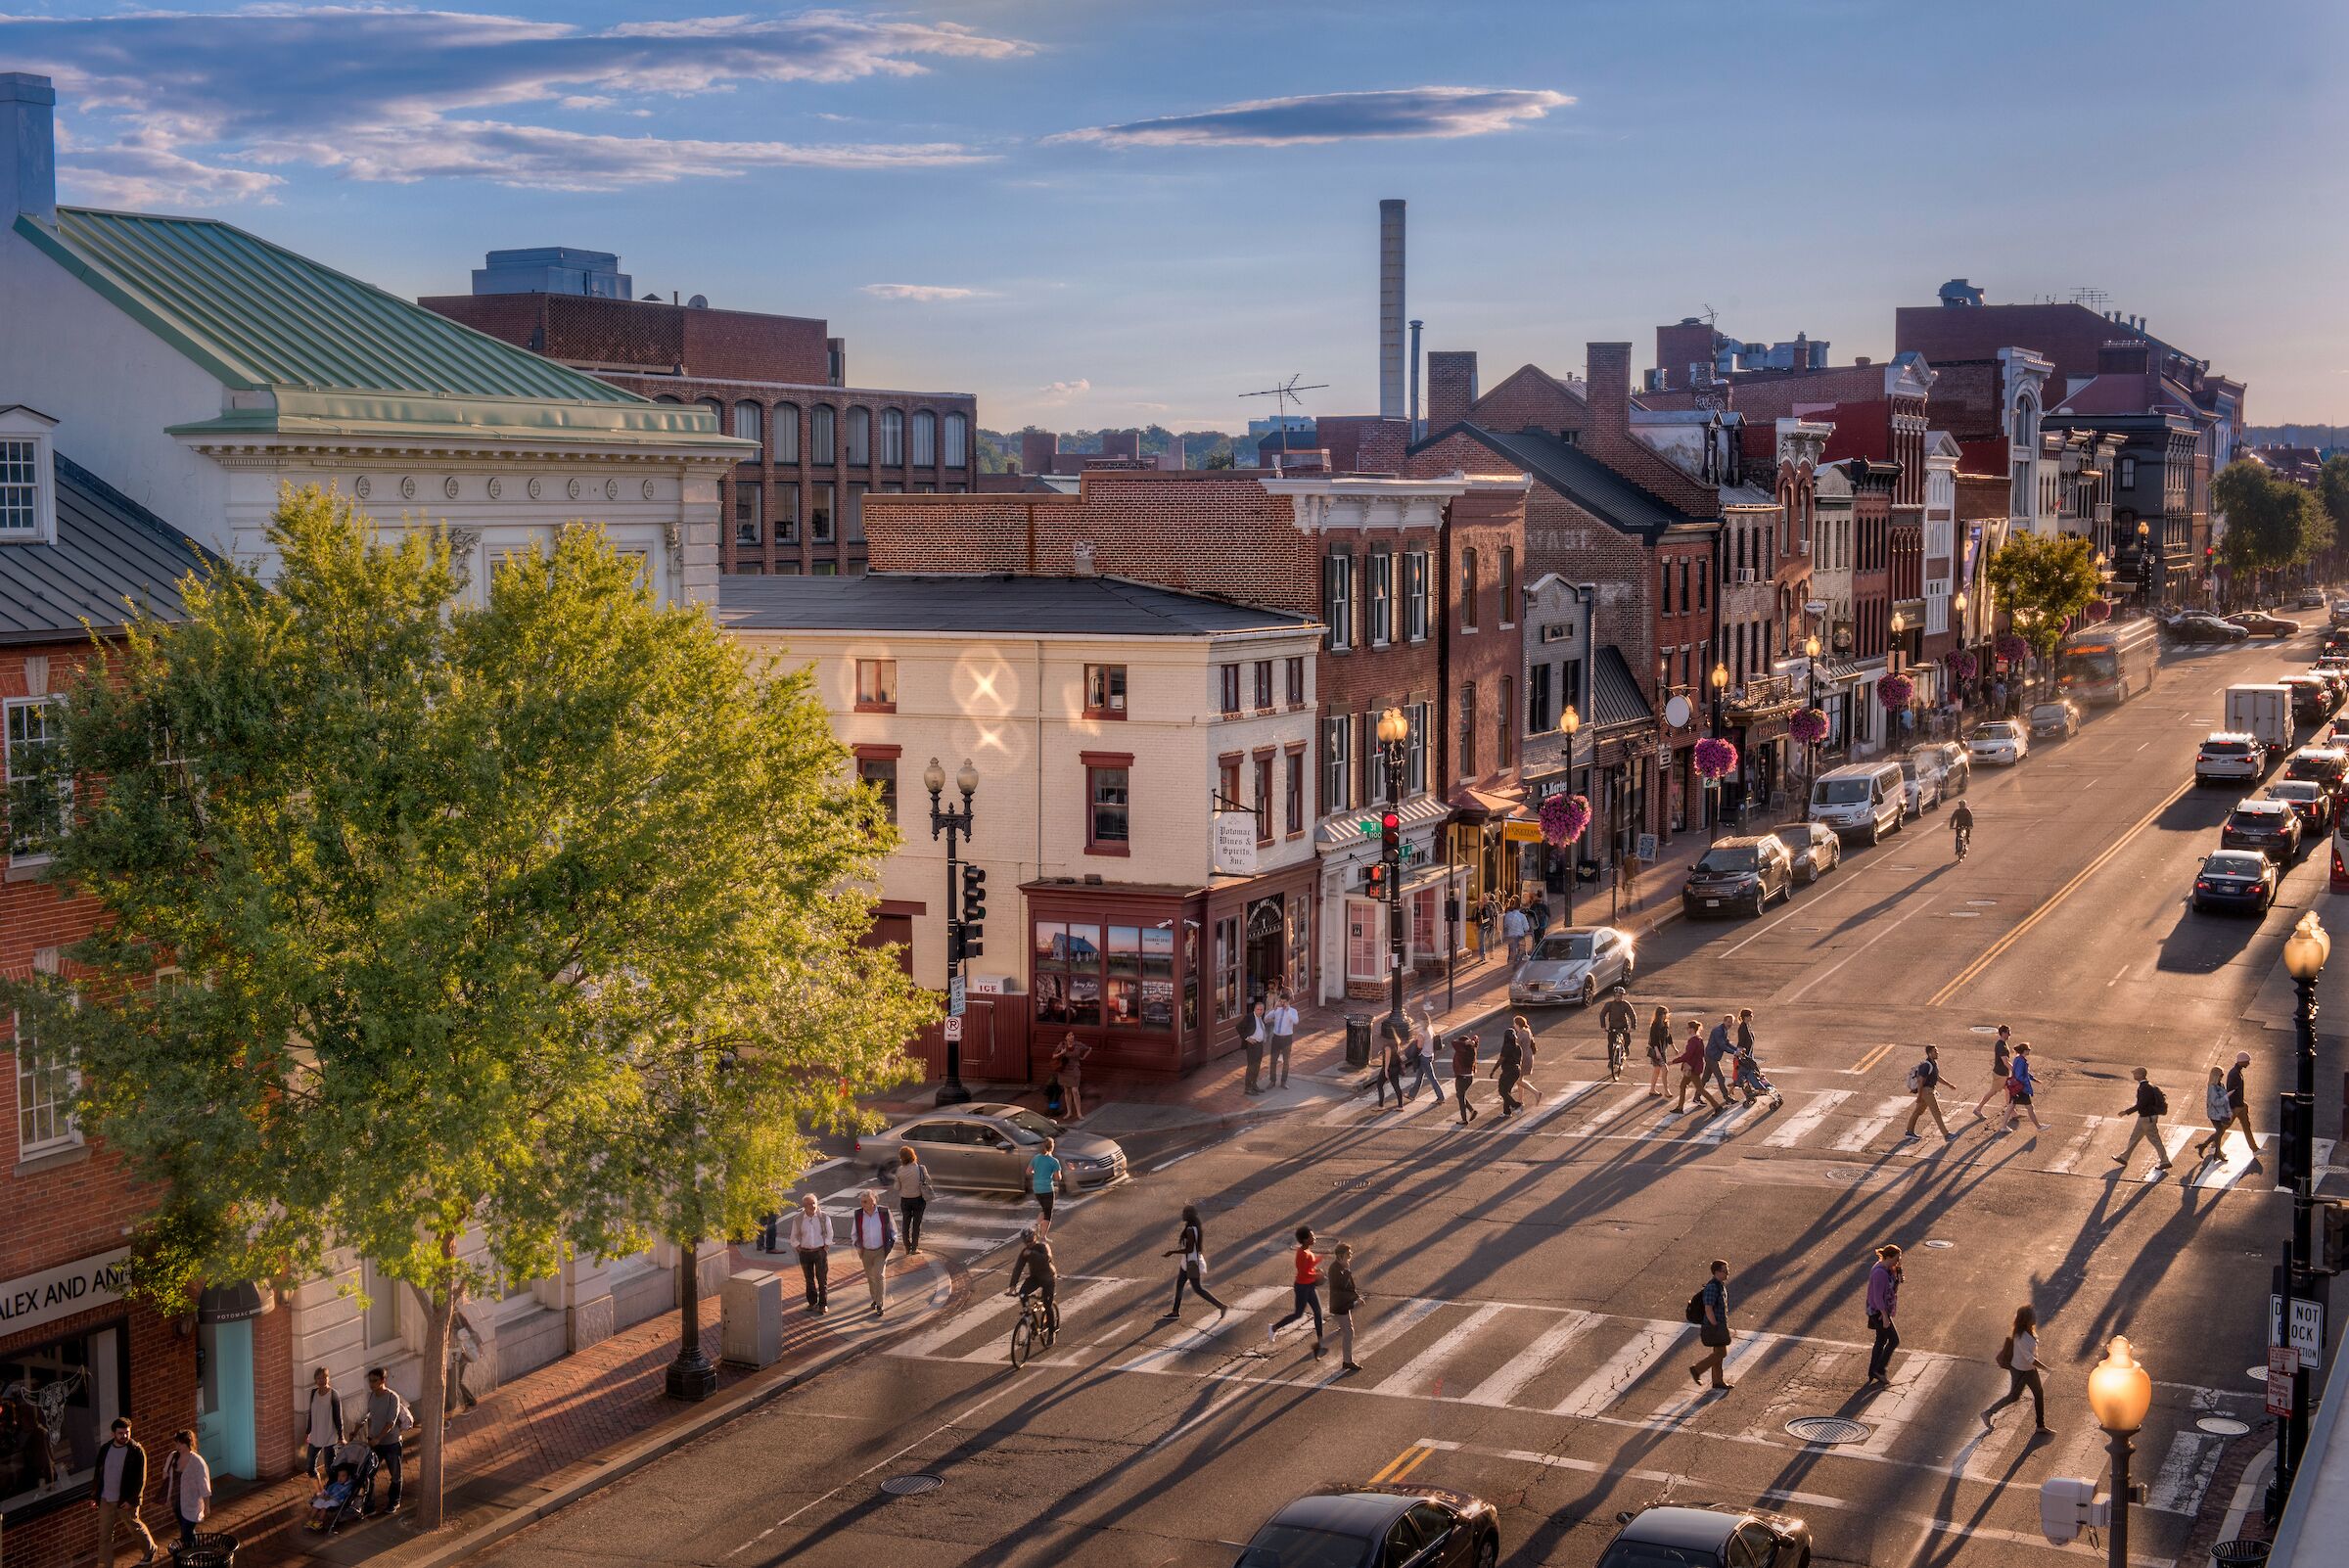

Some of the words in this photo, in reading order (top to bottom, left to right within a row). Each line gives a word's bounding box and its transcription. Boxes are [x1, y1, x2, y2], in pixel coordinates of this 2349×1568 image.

[1220, 826, 1251, 836] Potomac
[1508, 826, 1541, 836] L'OCCITAN
[1229, 856, 1245, 865] Inc.
[44, 1275, 86, 1309] AND
[217, 1311, 249, 1320] POTOMAC
[2296, 1306, 2319, 1322] NOT
[2279, 1321, 2313, 1341] BOCK
[2270, 1373, 2279, 1382] No
